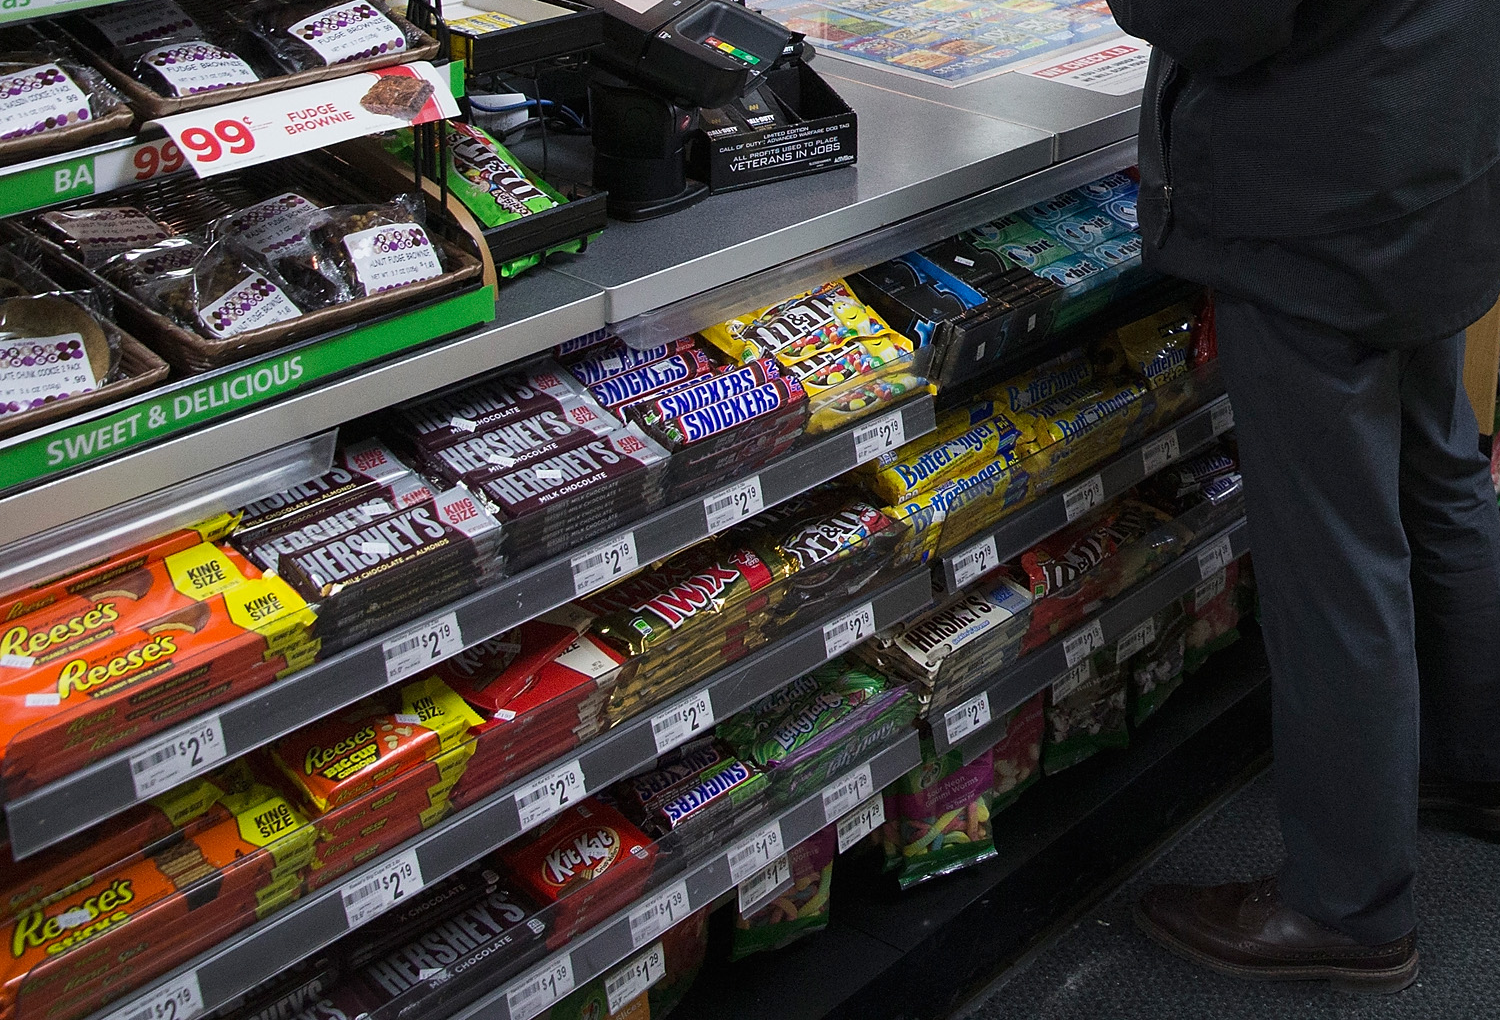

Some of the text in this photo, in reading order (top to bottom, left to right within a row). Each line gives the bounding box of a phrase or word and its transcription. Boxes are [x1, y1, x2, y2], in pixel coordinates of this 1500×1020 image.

[318, 31, 347, 46] FUDGE
[347, 17, 386, 37] BROWNIE
[166, 60, 244, 73] FUDGE BROWNIE
[1063, 52, 1111, 71] CHECK
[284, 111, 355, 136] BROWNIE
[287, 102, 337, 123] FUDGE
[719, 145, 736, 153] CALL
[767, 134, 798, 145] ADVANCED
[799, 128, 826, 138] WARFARE
[763, 126, 809, 140] LIMITED EDITION
[729, 153, 793, 172] VETERANS
[795, 148, 808, 159] IN
[810, 142, 841, 156] JOBS
[733, 154, 748, 162] ALL
[750, 148, 780, 159] PROFITS
[782, 143, 802, 153] USED
[816, 136, 839, 146] PLACE
[592, 354, 688, 406] SNICKERS
[661, 368, 755, 420] SNICKERS
[47, 355, 305, 466] SWEET & DELICIOUS
[683, 383, 780, 443] SNICKERS
[352, 448, 383, 465] KING
[437, 410, 572, 474] HERSHEY'S
[357, 456, 388, 472] SIZE
[486, 440, 621, 505] HERSHEY'S
[264, 500, 310, 520] CHOCOLATE
[321, 482, 357, 499] ALMONDS
[538, 471, 608, 504] MILK CHOCOLATE
[442, 498, 473, 517] KING
[452, 507, 479, 526] SIZE
[300, 507, 446, 588] HERSHEY'S
[361, 557, 404, 580] CHOCOLATE
[416, 538, 450, 557] ALMONDS
[185, 559, 222, 581] KING
[192, 569, 226, 591] SIZE
[243, 591, 278, 613] KING
[629, 562, 740, 630] TWIX
[250, 600, 285, 622] SIZE
[911, 593, 993, 655] HERSHEY'S
[0, 602, 119, 658] Reese's
[58, 635, 178, 700] Reese's
[304, 725, 377, 775] Reese's
[663, 762, 749, 823] SNICKERS
[254, 803, 288, 829] KING
[261, 813, 295, 839] SIZE
[455, 934, 514, 975] CHOCOLATE
